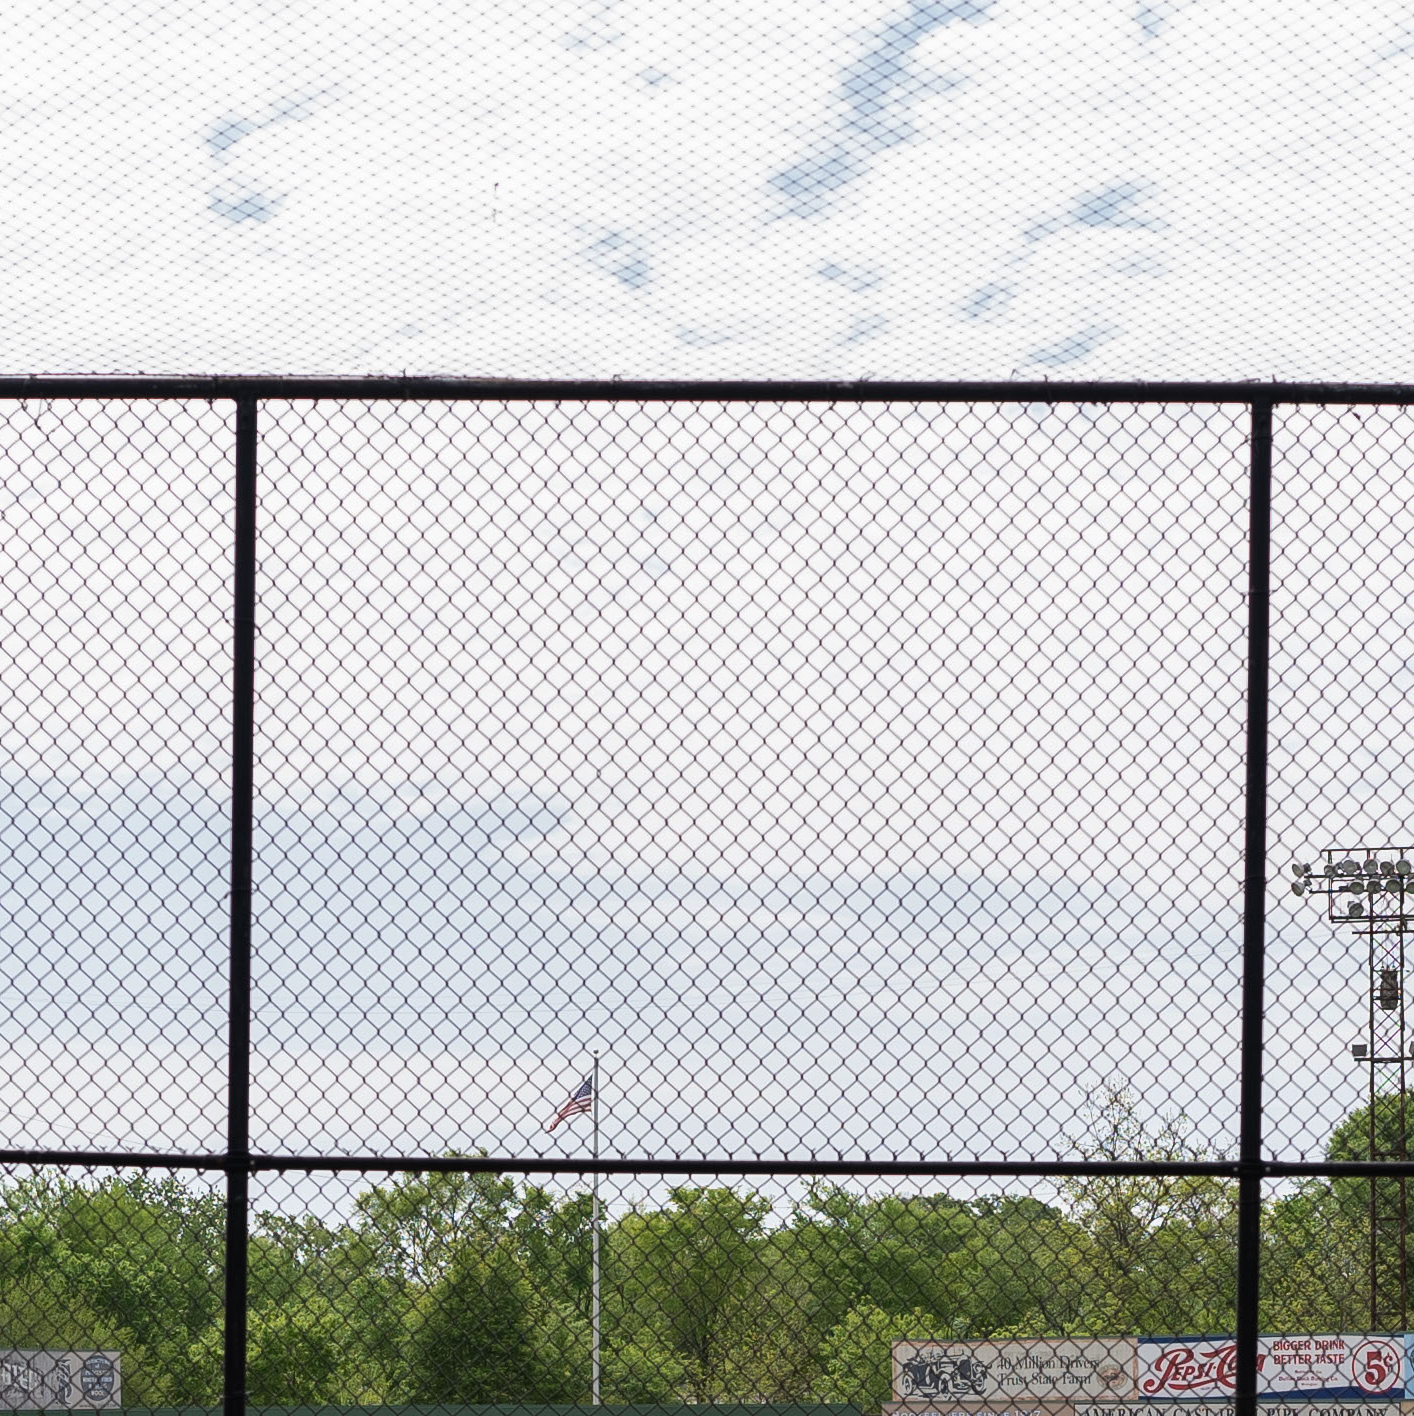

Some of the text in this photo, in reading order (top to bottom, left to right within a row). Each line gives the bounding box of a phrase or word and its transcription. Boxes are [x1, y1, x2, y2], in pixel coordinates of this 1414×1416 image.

[1272, 1339, 1346, 1352] BIGGER DRINK
[997, 1355, 1100, 1370] 40 Million Drivers
[1273, 1353, 1345, 1365] BETTER TASTE
[997, 1371, 1092, 1386] Trust State Farm
